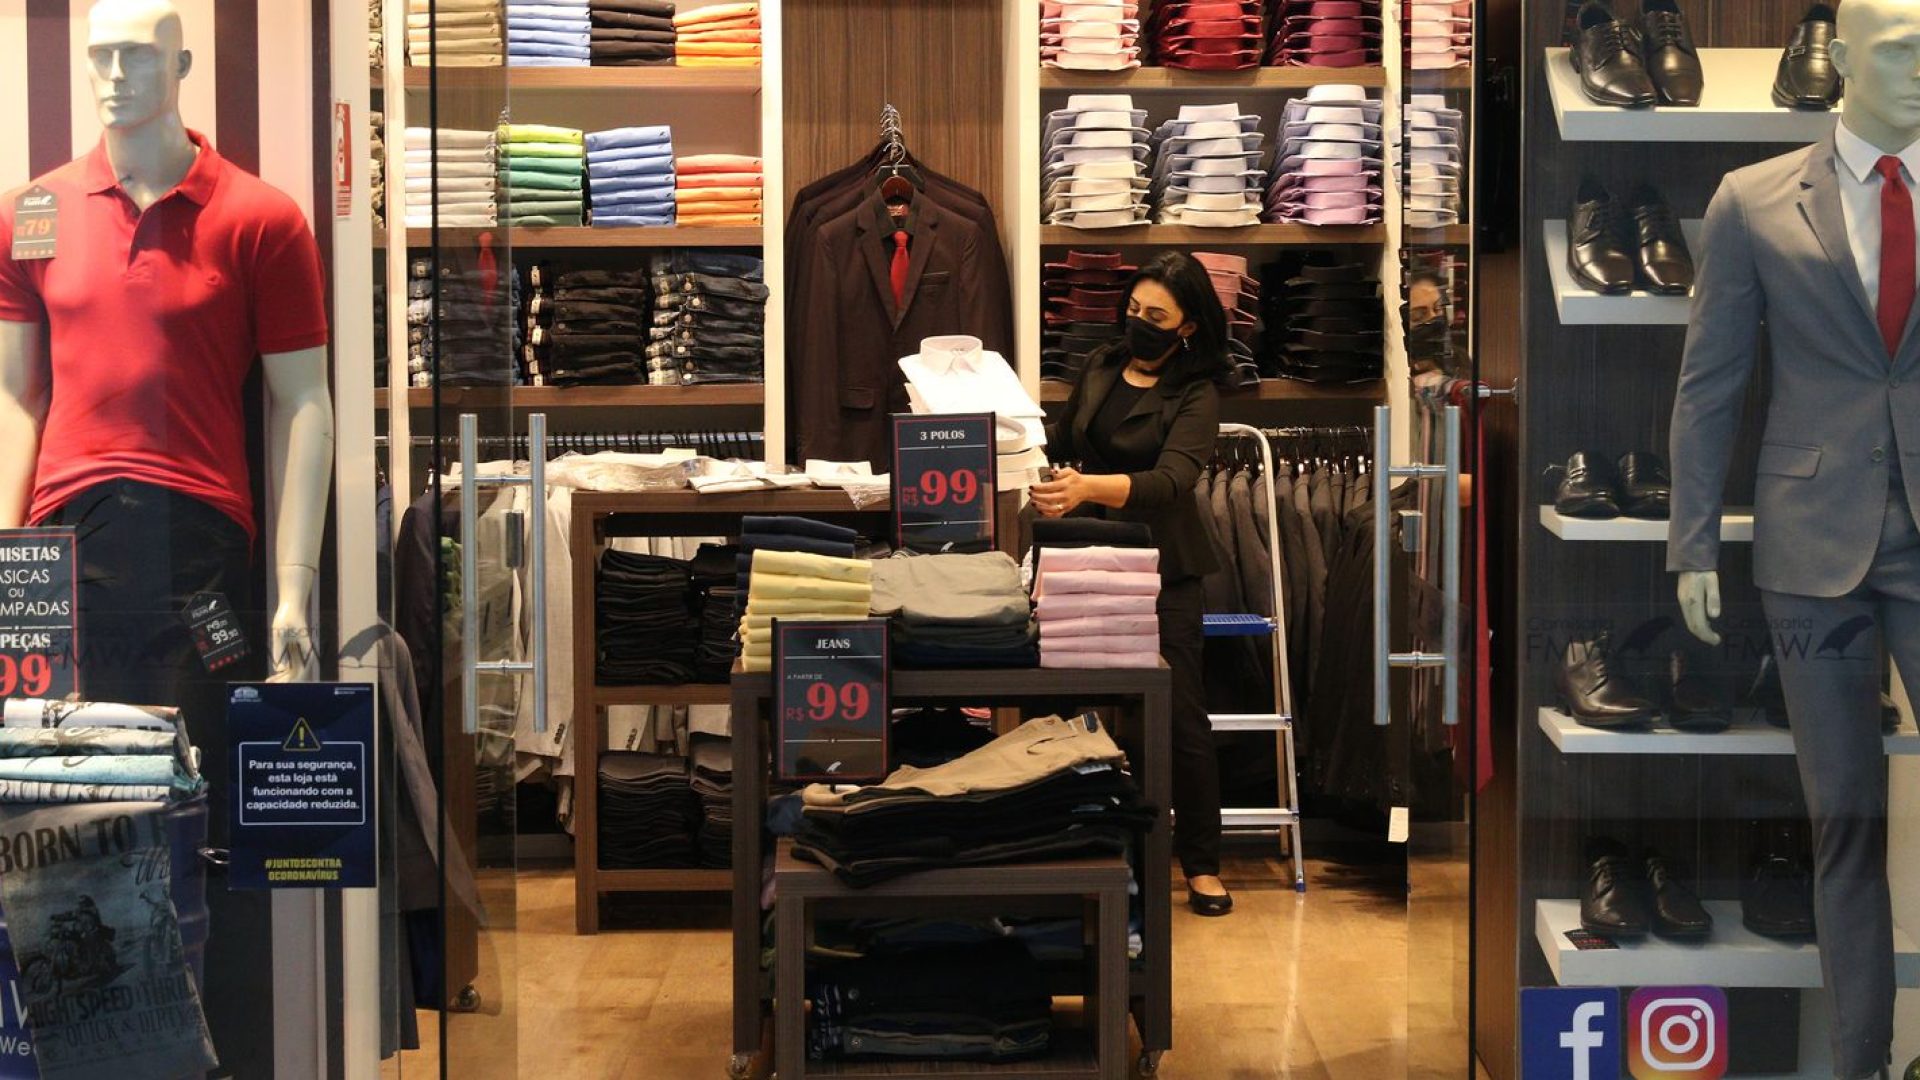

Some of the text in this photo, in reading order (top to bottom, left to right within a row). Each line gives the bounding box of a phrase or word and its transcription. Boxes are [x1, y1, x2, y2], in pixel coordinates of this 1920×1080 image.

[920, 430, 965, 440] 3 POLOS
[920, 469, 977, 506] 99
[0, 546, 61, 561] ISETAS
[8, 588, 25, 598] OU
[0, 633, 51, 653] PEÇAS
[816, 638, 851, 649] JEANS
[786, 682, 870, 722] R$ 99
[249, 760, 356, 771] Para sua segurança,
[268, 772, 338, 784] esta loja está
[253, 786, 353, 796] funcionando com a
[246, 799, 360, 811] capacidade reduzida.
[0, 823, 82, 875] BORN
[90, 815, 137, 857] TO
